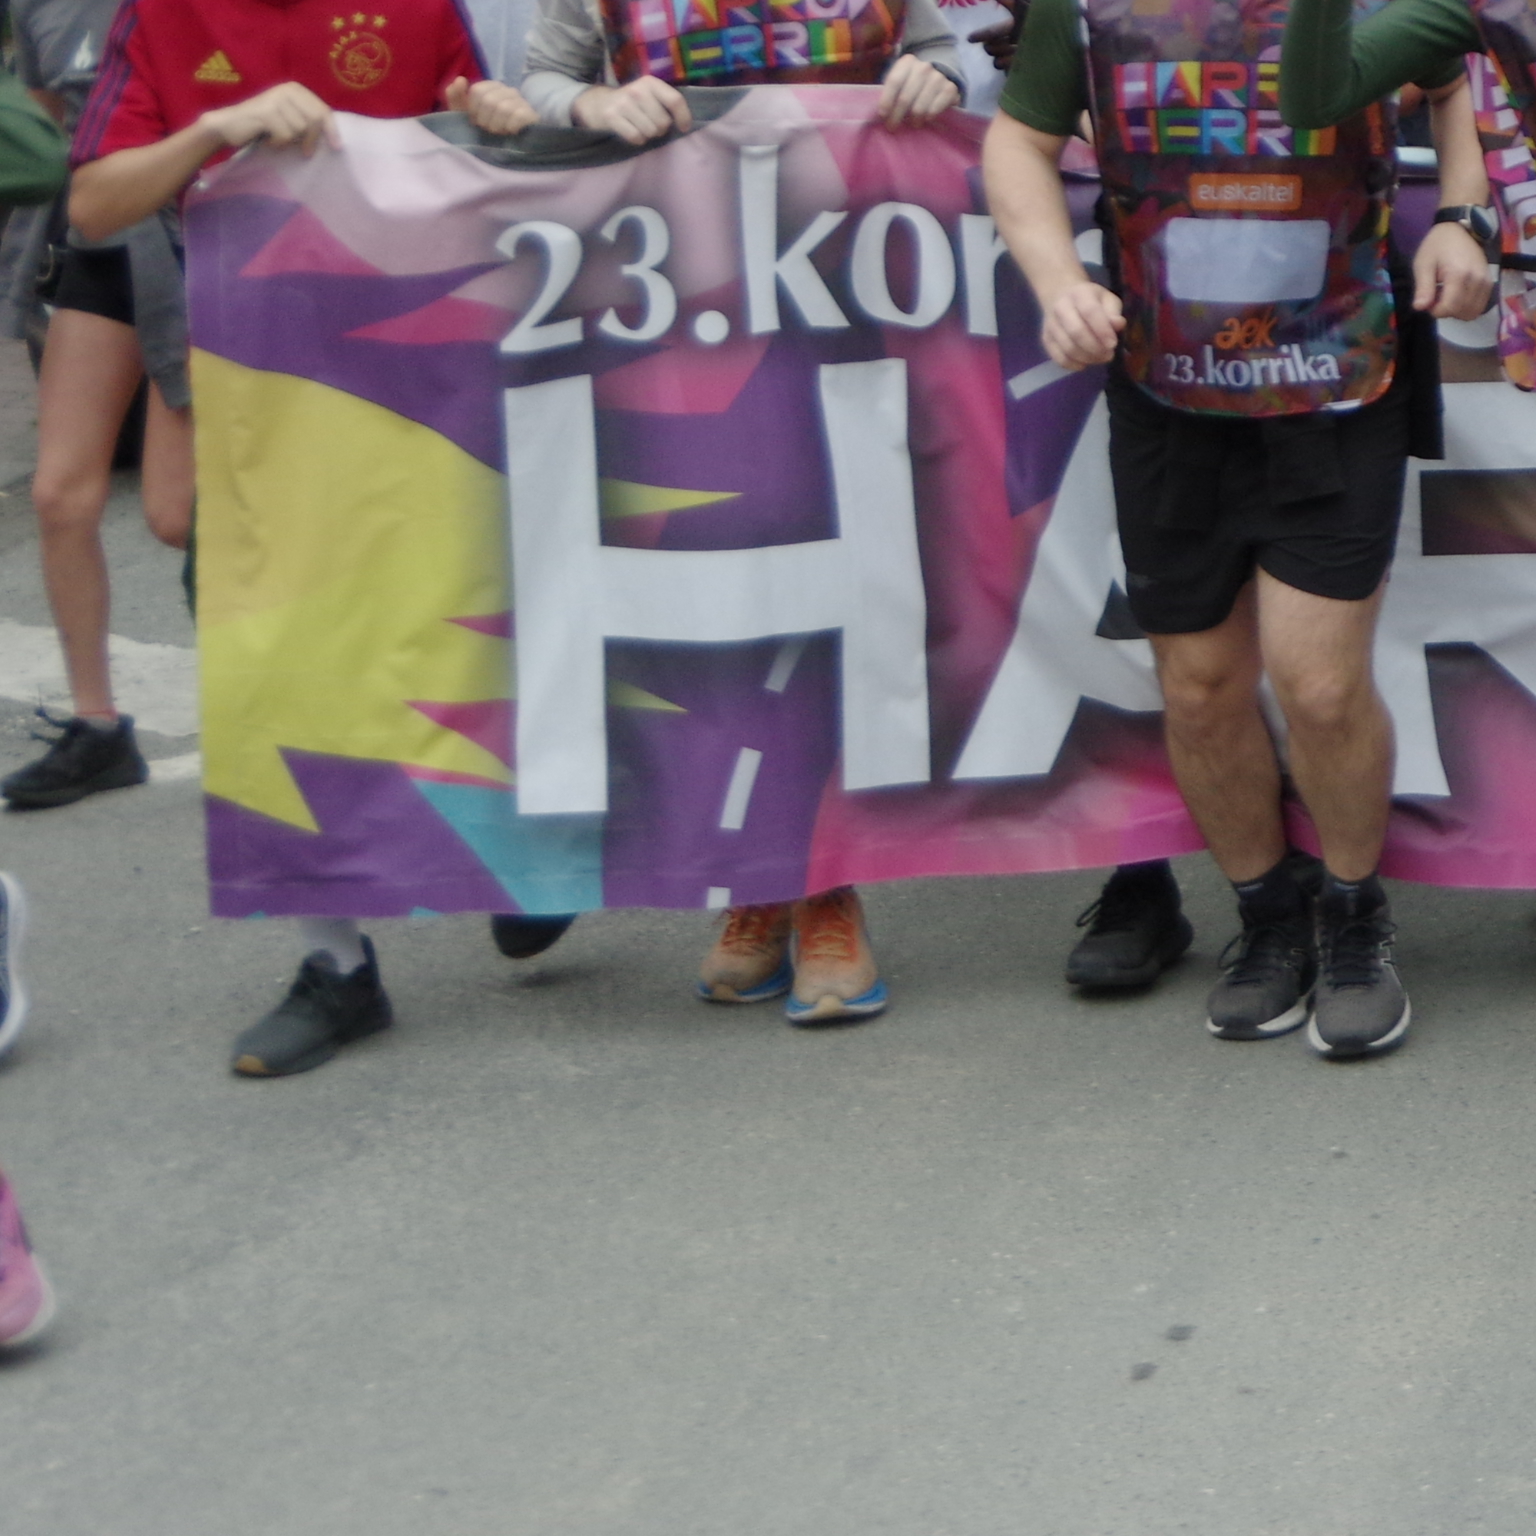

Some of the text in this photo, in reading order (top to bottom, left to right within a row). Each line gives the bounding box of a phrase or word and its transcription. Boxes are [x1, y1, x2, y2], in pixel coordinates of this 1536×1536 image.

[636, 18, 852, 82] HERRI
[1113, 60, 1281, 110] HARR
[1197, 180, 1294, 203] euskaltel
[1213, 306, 1280, 350] aek
[1162, 343, 1343, 388] 23.korrika
